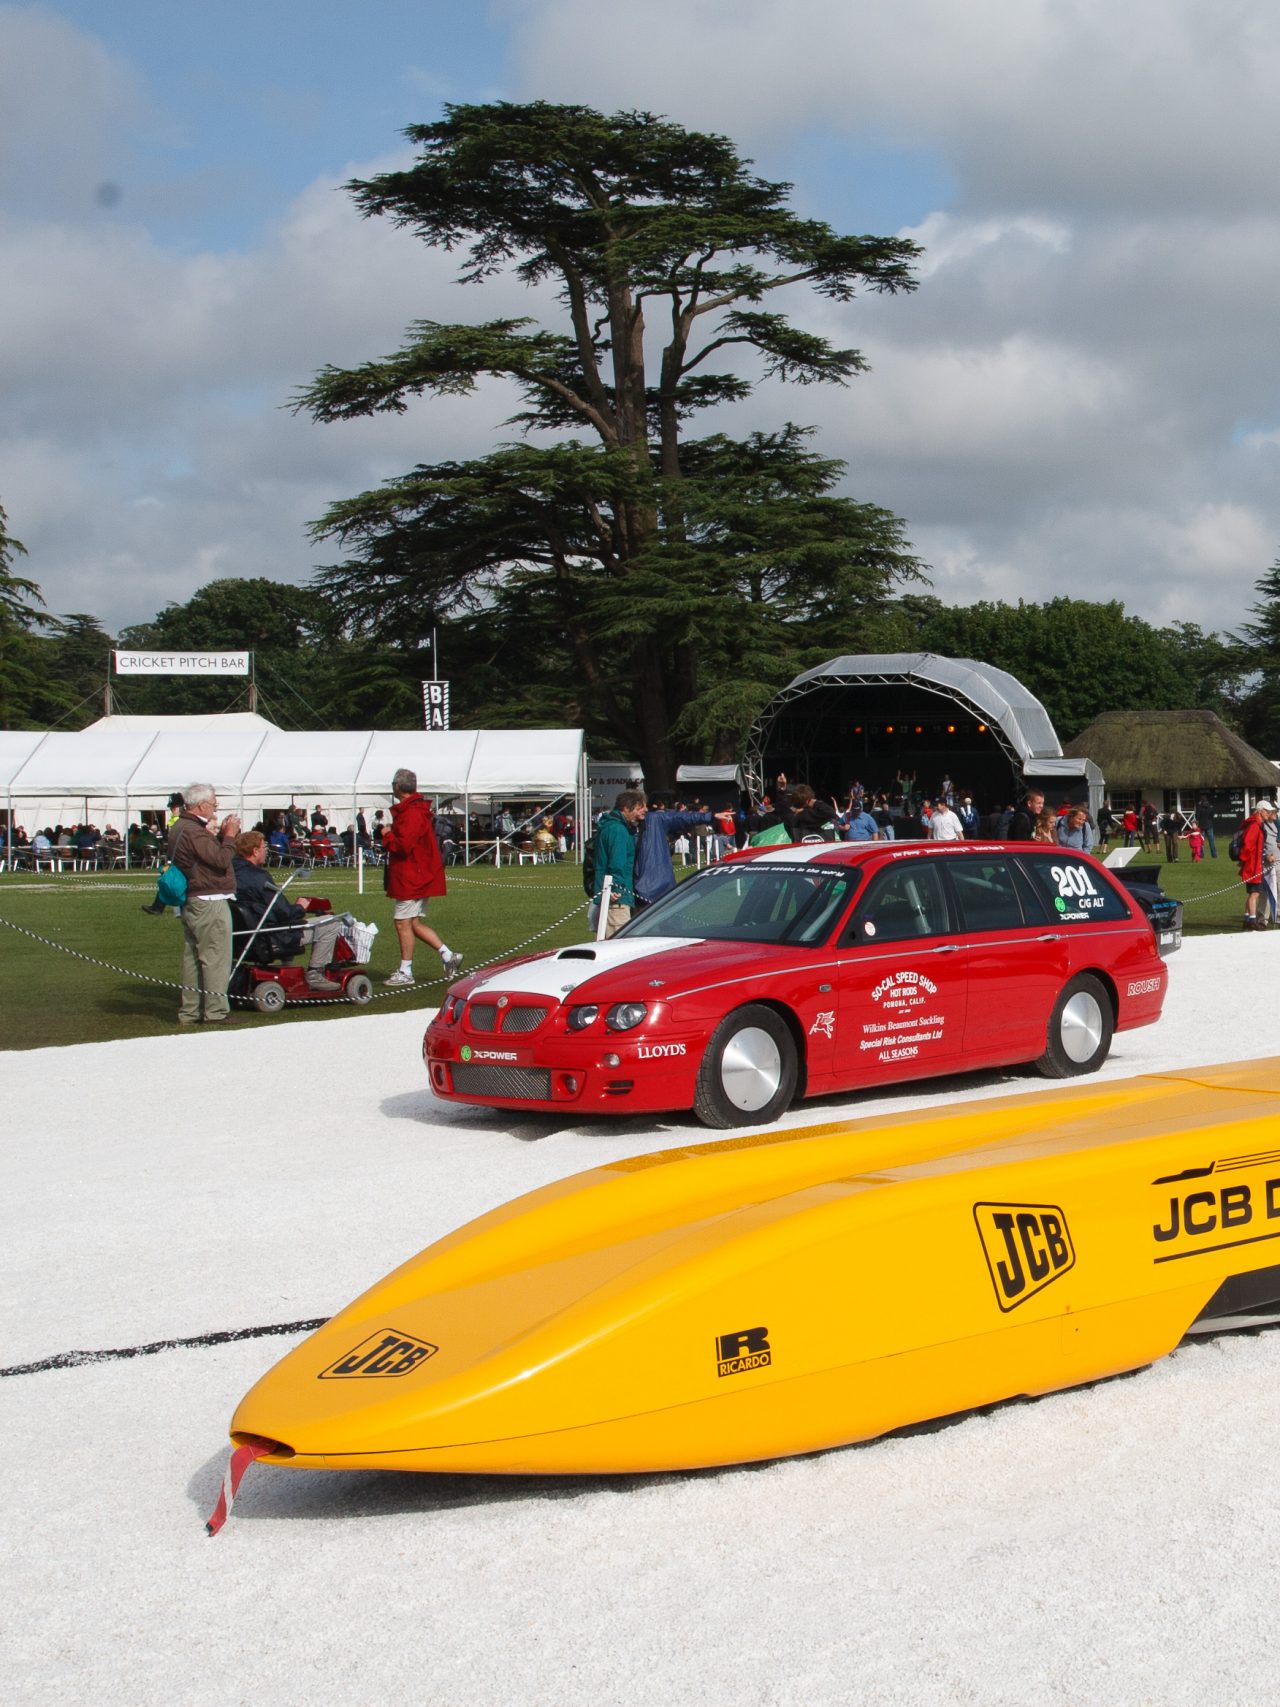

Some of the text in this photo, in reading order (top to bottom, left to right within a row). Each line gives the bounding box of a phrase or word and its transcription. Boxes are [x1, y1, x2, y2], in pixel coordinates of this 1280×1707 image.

[120, 657, 245, 668] CRICKET PITCH BAR
[1050, 866, 1098, 897] 201
[1093, 897, 1104, 908] ALT
[871, 971, 938, 1001] SO-CAL SPEED SHOP
[890, 986, 918, 998] HOT RODS
[1127, 977, 1161, 996] ROUSH
[862, 1014, 945, 1034] Wilkins Beaumont Suckling
[859, 1029, 944, 1051] Special Risk Consultants Ltd
[473, 1050, 518, 1060] XPOWER
[637, 1043, 686, 1059] LLOYD'S
[878, 1046, 919, 1061] ALL SEASONS
[1152, 1184, 1253, 1243] JCB
[991, 1212, 1069, 1299] JCB
[331, 1335, 430, 1374] JCB
[719, 1353, 770, 1376] RICARDO
